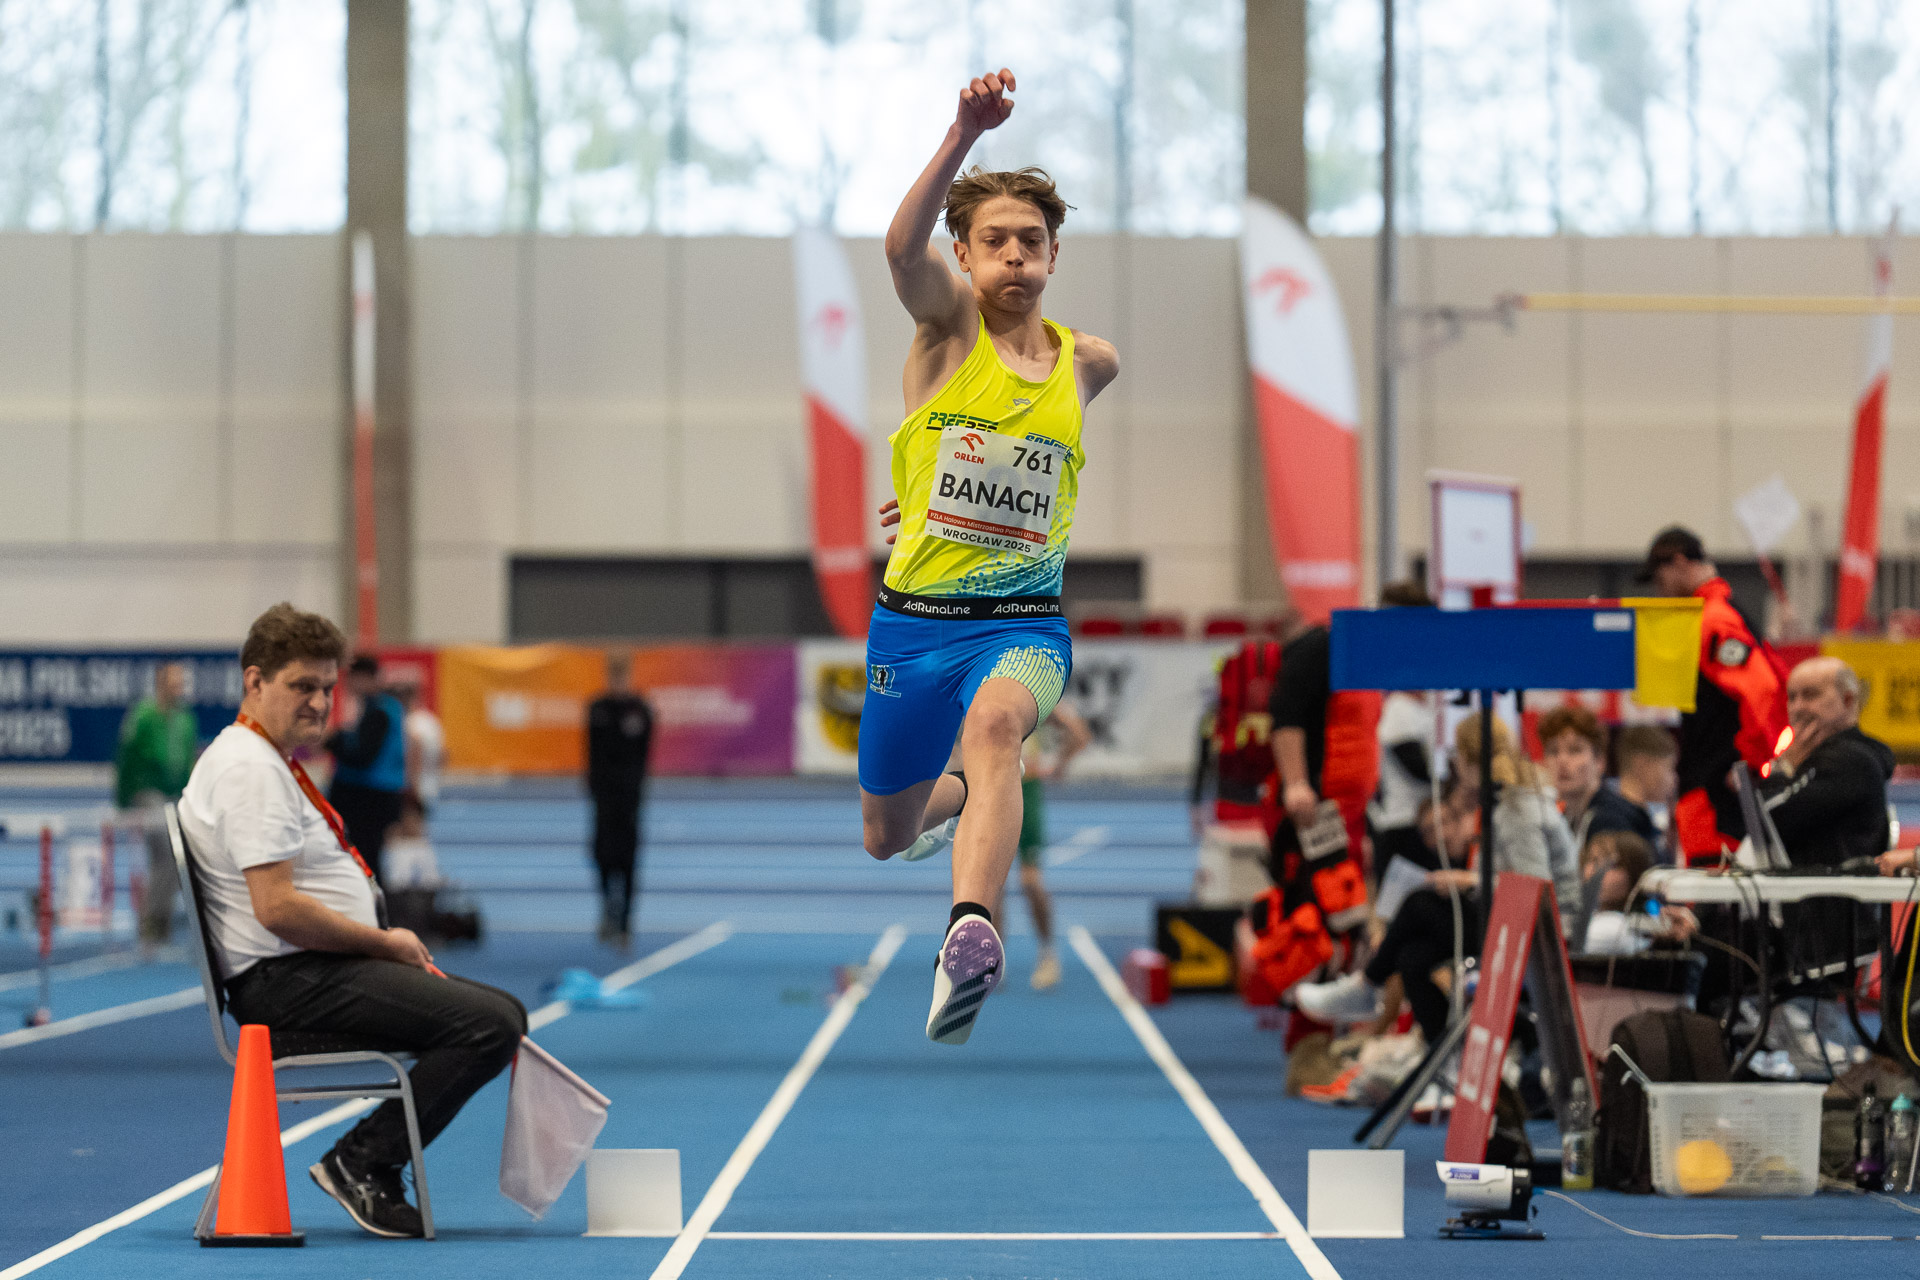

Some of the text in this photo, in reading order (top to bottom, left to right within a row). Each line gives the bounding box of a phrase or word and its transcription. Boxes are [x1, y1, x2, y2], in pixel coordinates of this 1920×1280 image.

[953, 451, 985, 465] ORLEN
[1012, 445, 1053, 475] 761
[938, 472, 1051, 519] BANACH
[930, 512, 943, 521] PZLA
[944, 516, 966, 526] Halowe
[967, 521, 1004, 533] Mistrzostwa
[1005, 529, 1023, 537] Polski
[942, 527, 1032, 553] WROCŁAW 2025
